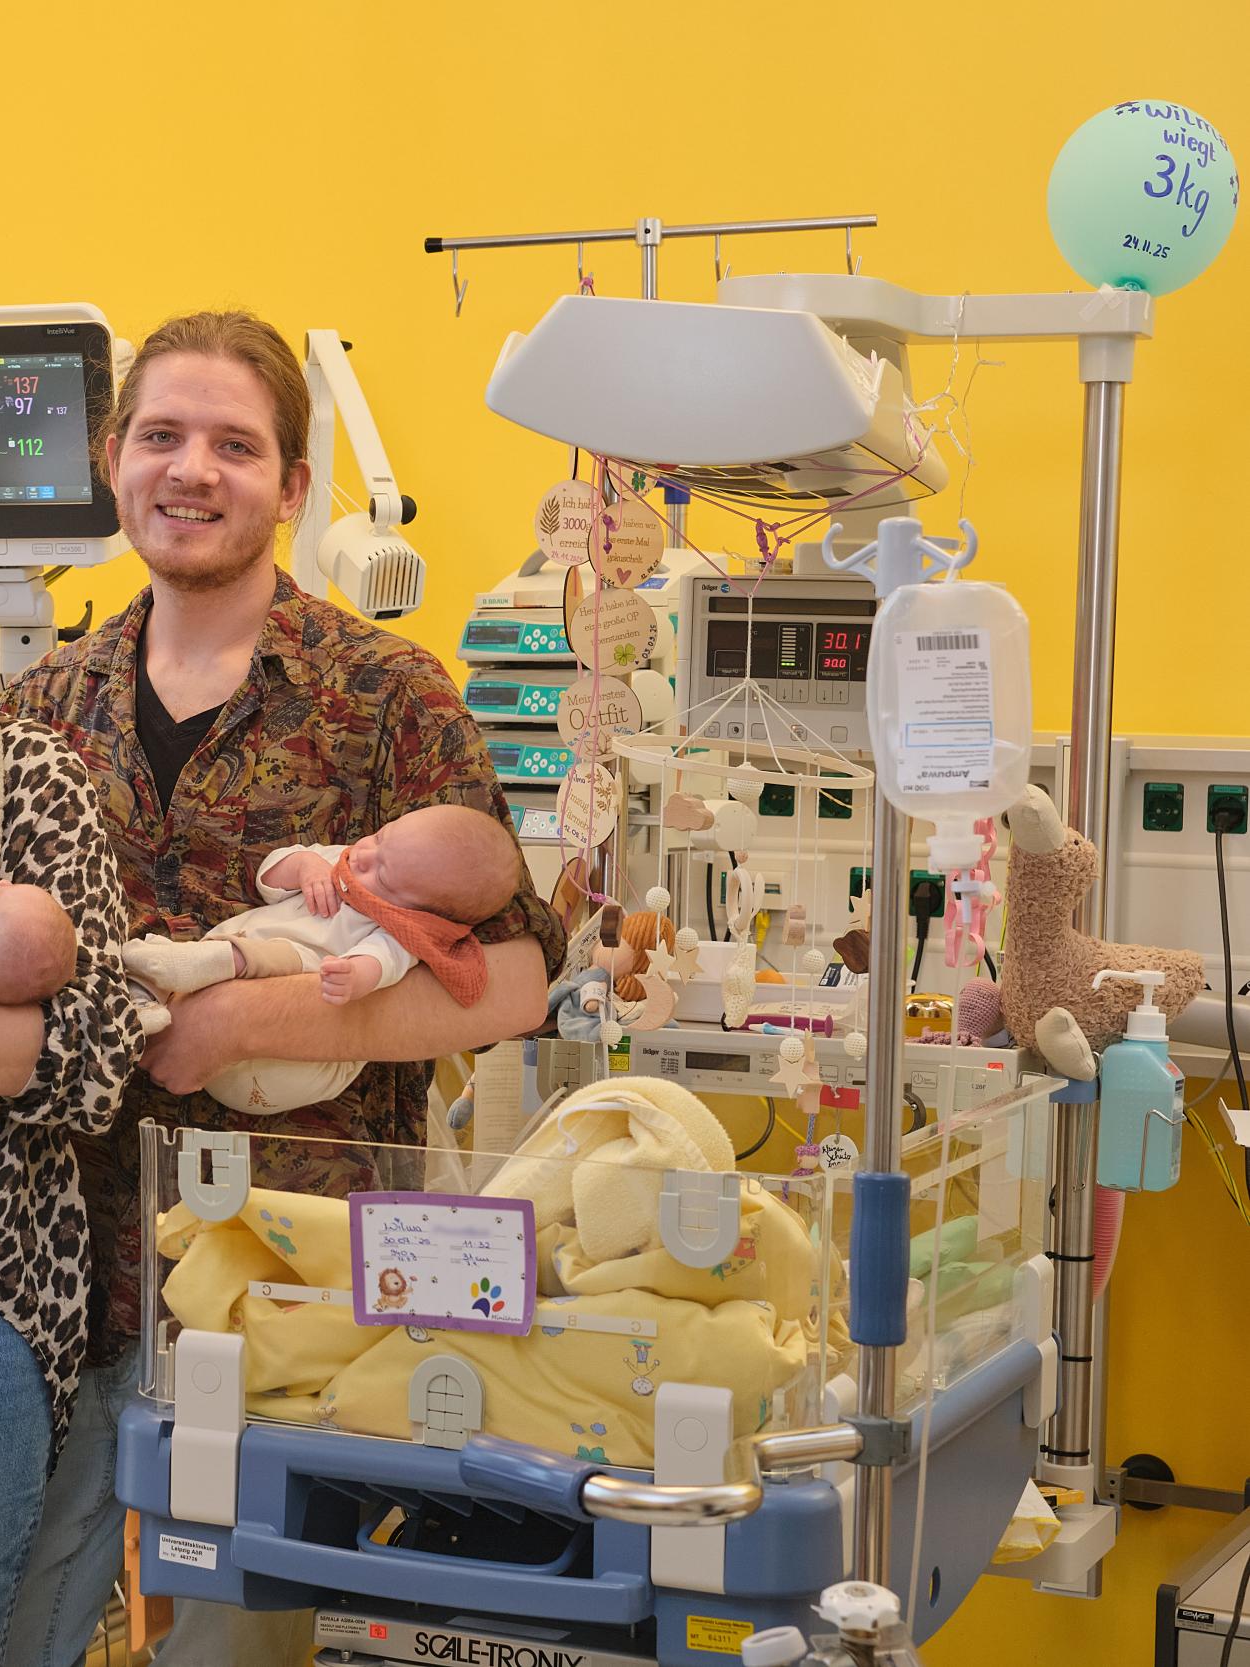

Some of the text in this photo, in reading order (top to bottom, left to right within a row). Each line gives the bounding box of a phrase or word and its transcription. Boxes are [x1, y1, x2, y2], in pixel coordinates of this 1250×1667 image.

[1163, 126, 1217, 168] wiegt
[13, 376, 39, 394] 137
[14, 397, 67, 415] 97 137
[17, 438, 44, 456] 112
[562, 497, 576, 509] Ich
[579, 604, 605, 617] Heue
[626, 611, 640, 623] OP
[823, 632, 861, 650] 30.1
[662, 1049, 680, 1057] Scale
[161, 1536, 216, 1552] Universitätsklinikum
[171, 1545, 191, 1555] Leipzig
